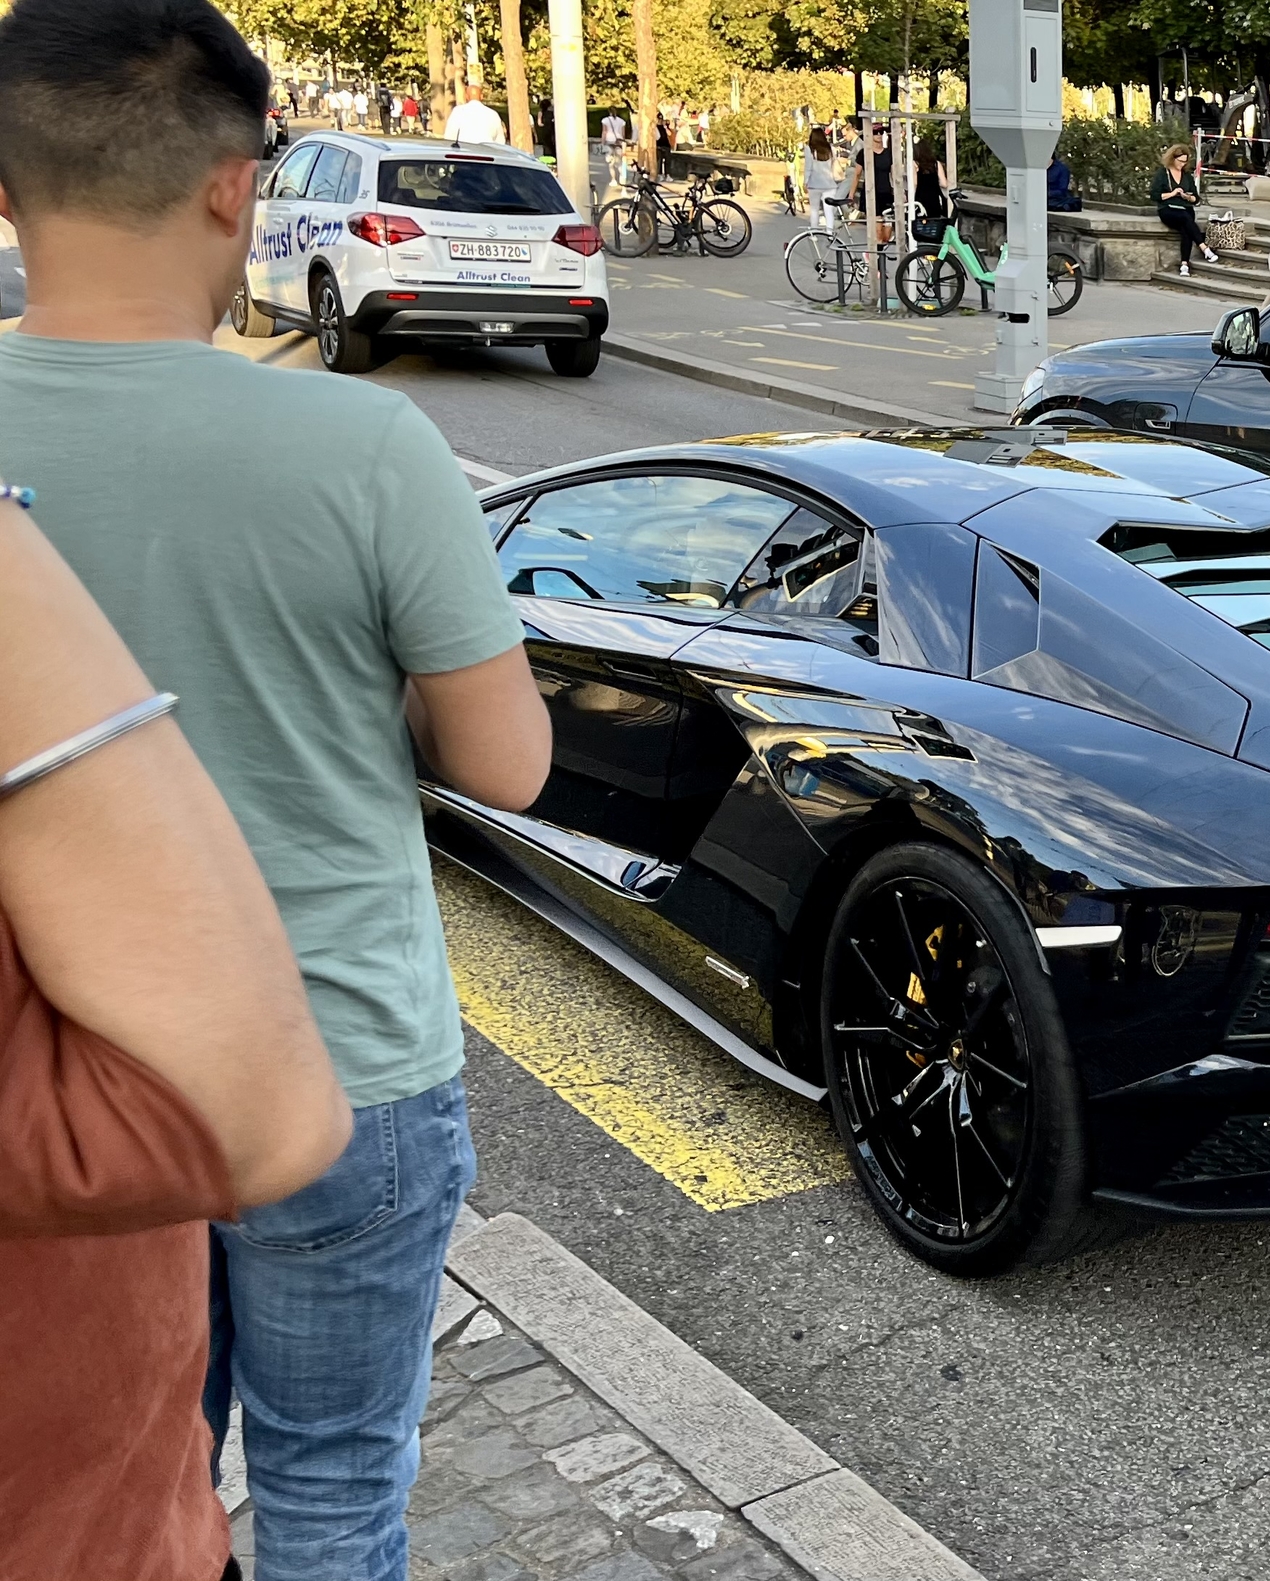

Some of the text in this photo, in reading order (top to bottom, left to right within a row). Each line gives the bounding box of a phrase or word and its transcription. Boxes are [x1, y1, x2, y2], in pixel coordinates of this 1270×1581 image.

[249, 212, 344, 266] Alltrust Clean
[456, 271, 532, 283] Alltrust Clean
